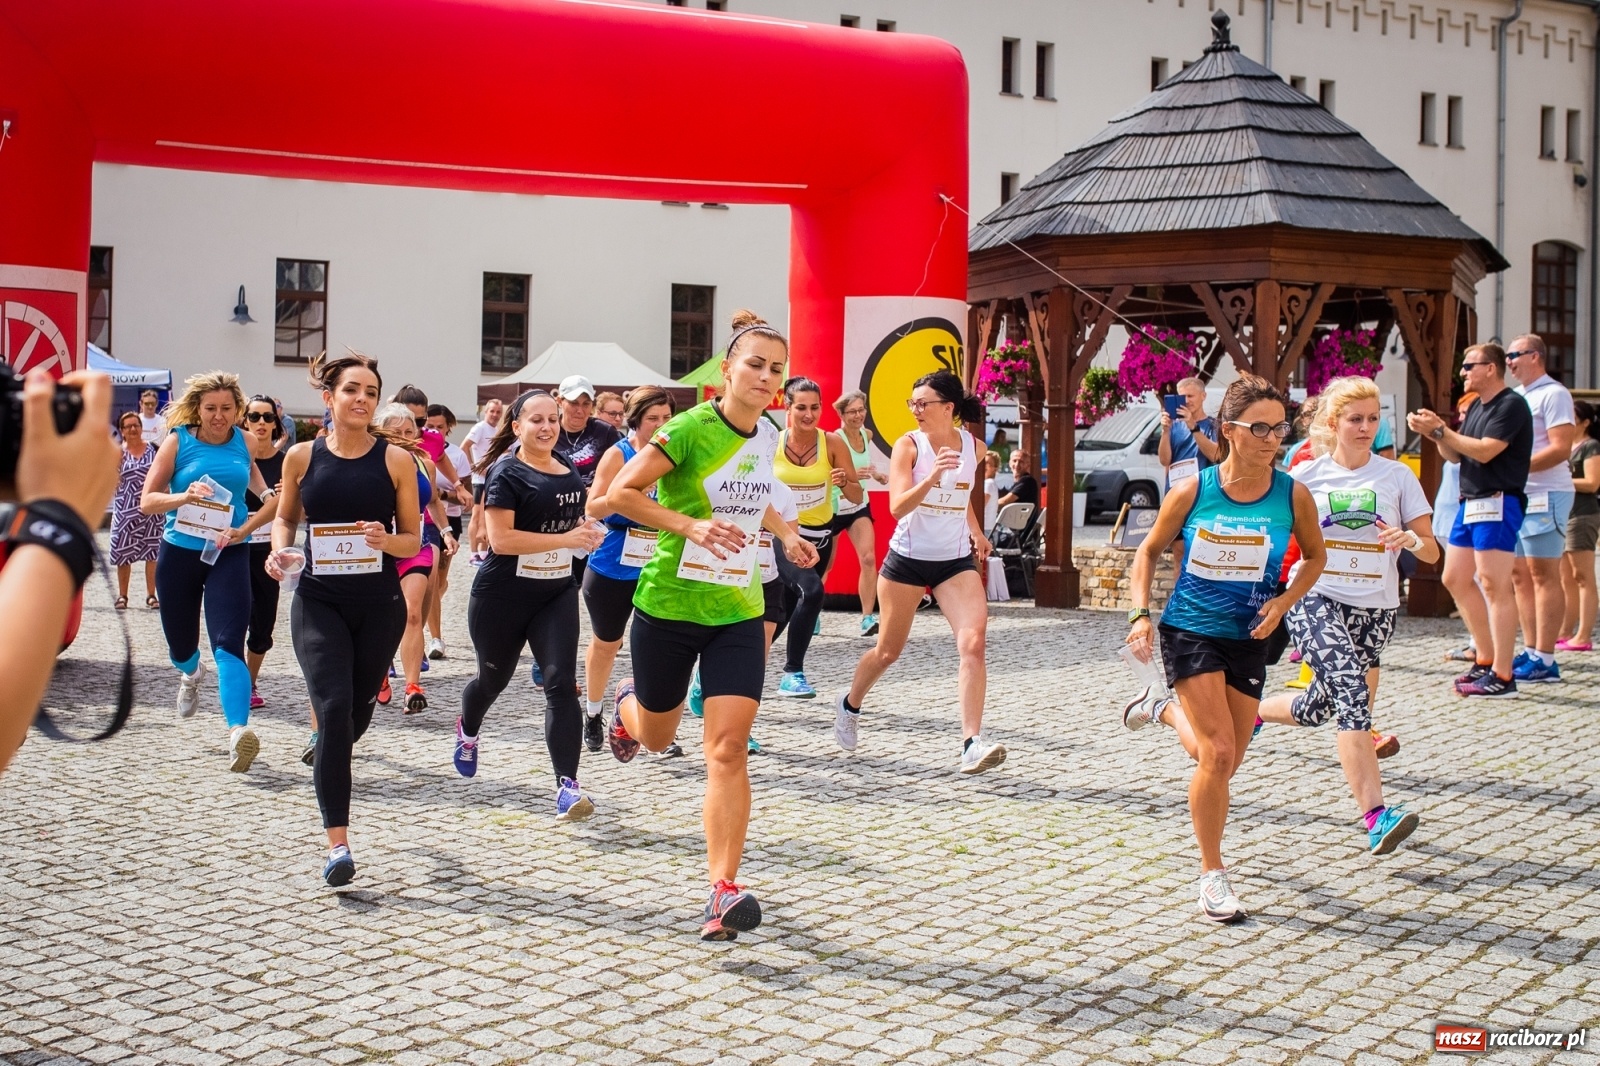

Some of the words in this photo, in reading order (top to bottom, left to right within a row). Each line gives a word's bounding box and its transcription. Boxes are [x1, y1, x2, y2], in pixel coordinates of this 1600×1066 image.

[719, 481, 771, 494] AKTYWNI
[938, 494, 952, 503] 17
[1334, 491, 1373, 502] REBEL
[712, 505, 761, 516] GEOFART
[1476, 502, 1485, 510] 18
[199, 512, 206, 522] 4
[335, 541, 354, 555] 42
[643, 543, 656, 553] 40
[544, 552, 558, 564] 29
[1217, 550, 1237, 562] 28
[1350, 556, 1358, 568] 8
